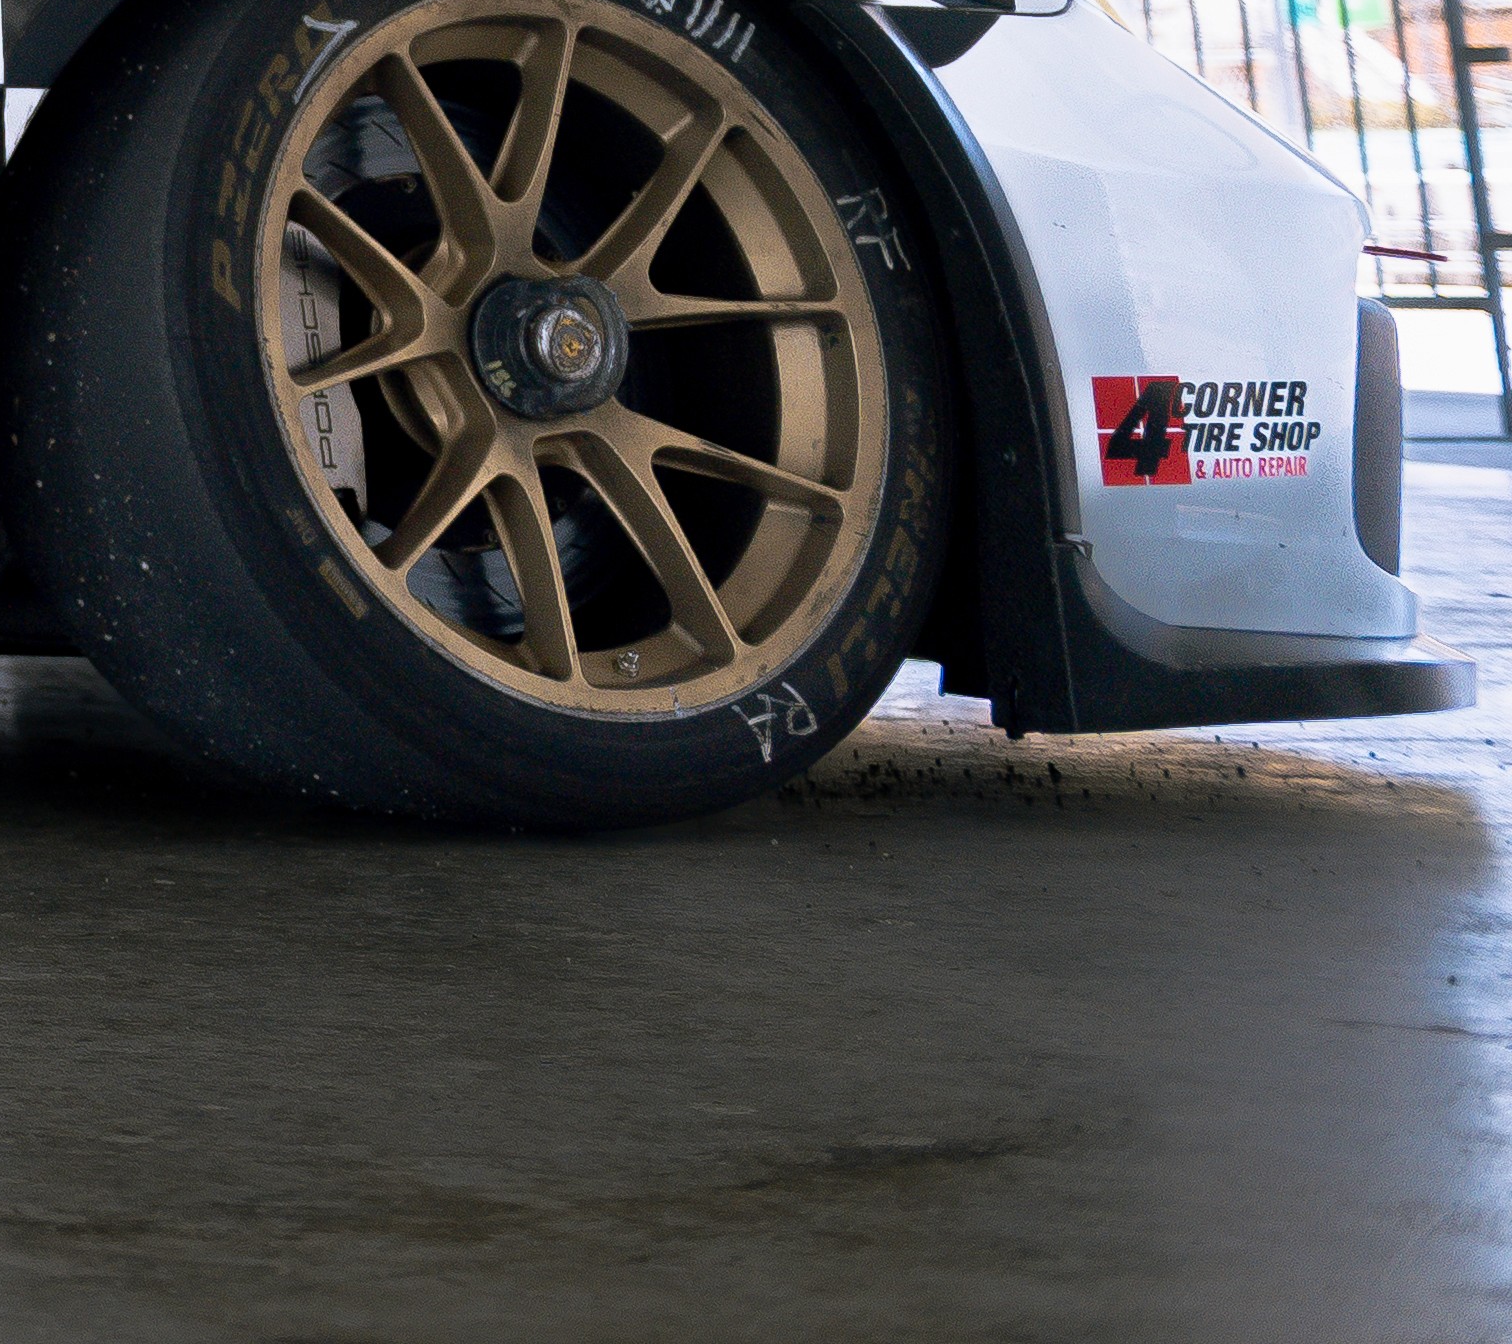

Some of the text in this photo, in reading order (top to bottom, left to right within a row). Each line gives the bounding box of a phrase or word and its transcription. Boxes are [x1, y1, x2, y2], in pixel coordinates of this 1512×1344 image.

[212, 238, 242, 311] P
[1105, 380, 1308, 476] 4 CORNER
[1181, 421, 1322, 453] TIRE SHOP
[1195, 456, 1308, 479] & AUTO REPAIR
